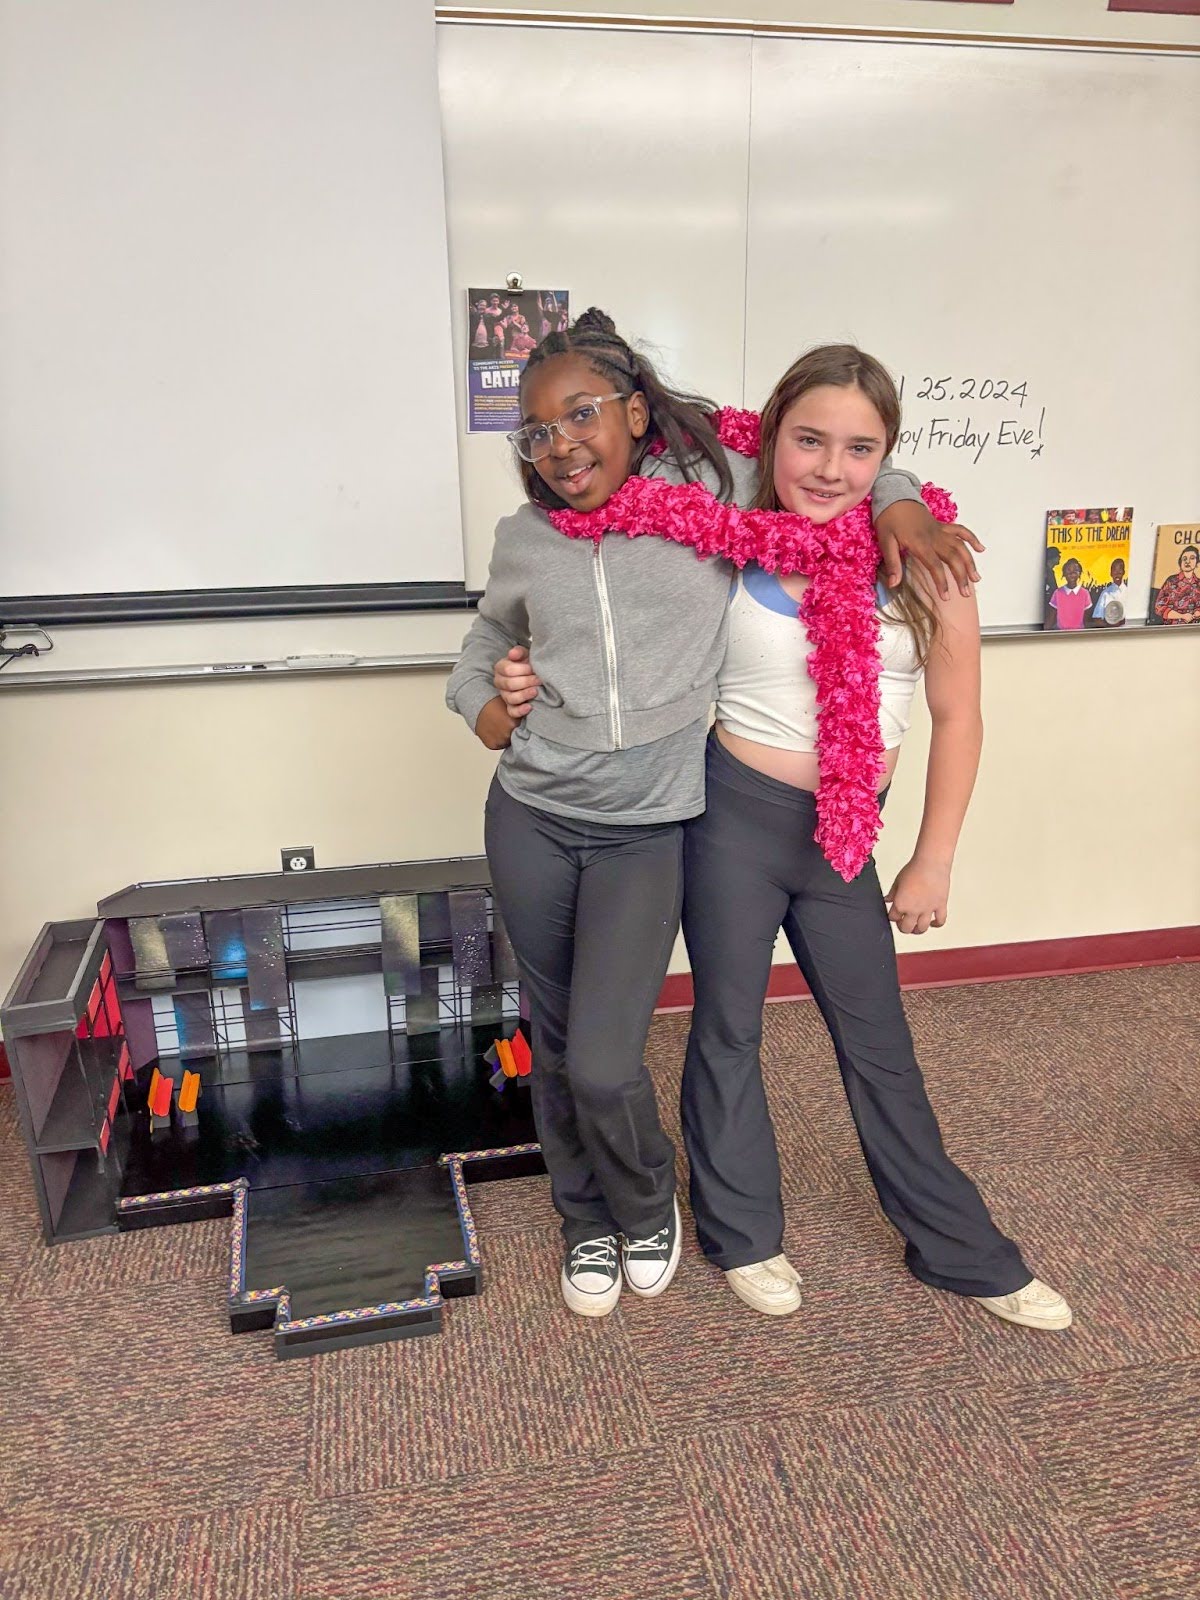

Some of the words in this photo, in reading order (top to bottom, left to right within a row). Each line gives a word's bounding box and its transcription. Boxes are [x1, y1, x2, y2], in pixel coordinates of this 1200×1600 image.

[481, 369, 520, 389] CATA
[928, 417, 990, 464] Friday
[997, 407, 1045, 460] Eve!
[1050, 527, 1072, 543] THIS
[1075, 527, 1083, 543] IS
[1086, 526, 1104, 542] THE
[1106, 525, 1130, 541] DREAM
